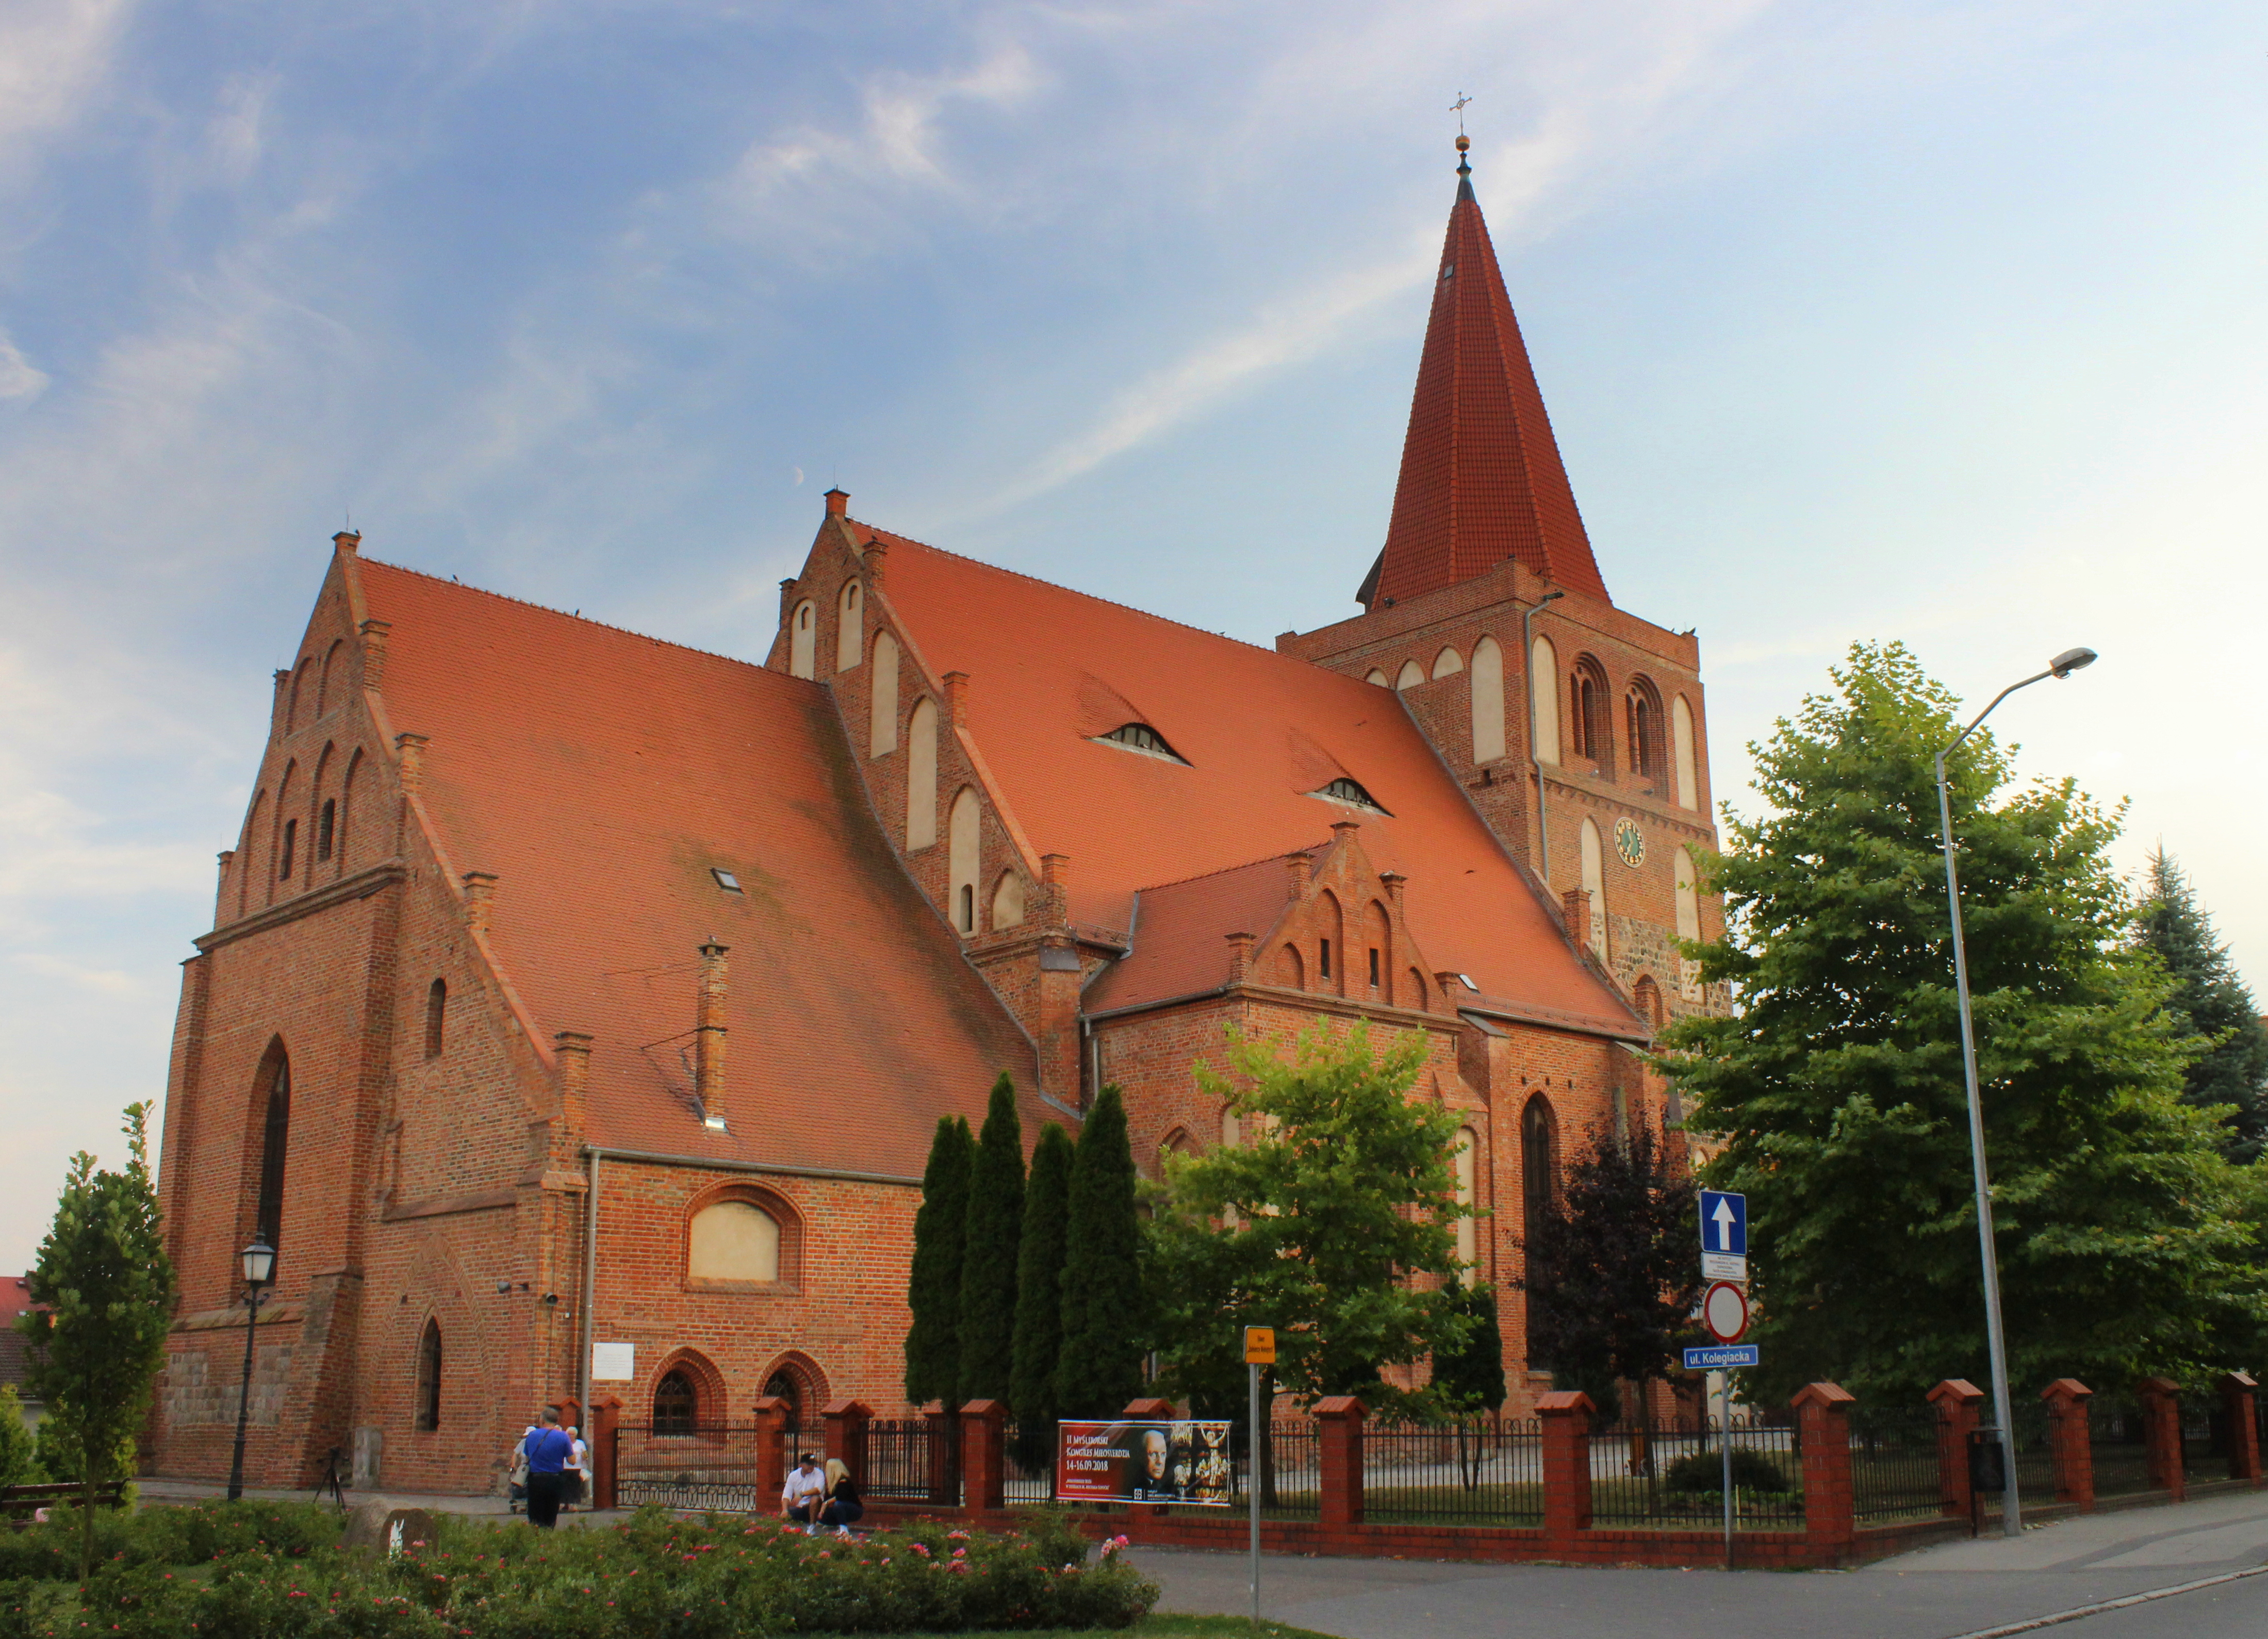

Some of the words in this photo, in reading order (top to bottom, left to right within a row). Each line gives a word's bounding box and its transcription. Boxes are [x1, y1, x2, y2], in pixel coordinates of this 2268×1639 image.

[1689, 1353, 1700, 1364] ul.
[1702, 1350, 1750, 1365] Kolegiacka
[1066, 1460, 1109, 1471] 14-16.09.2018
